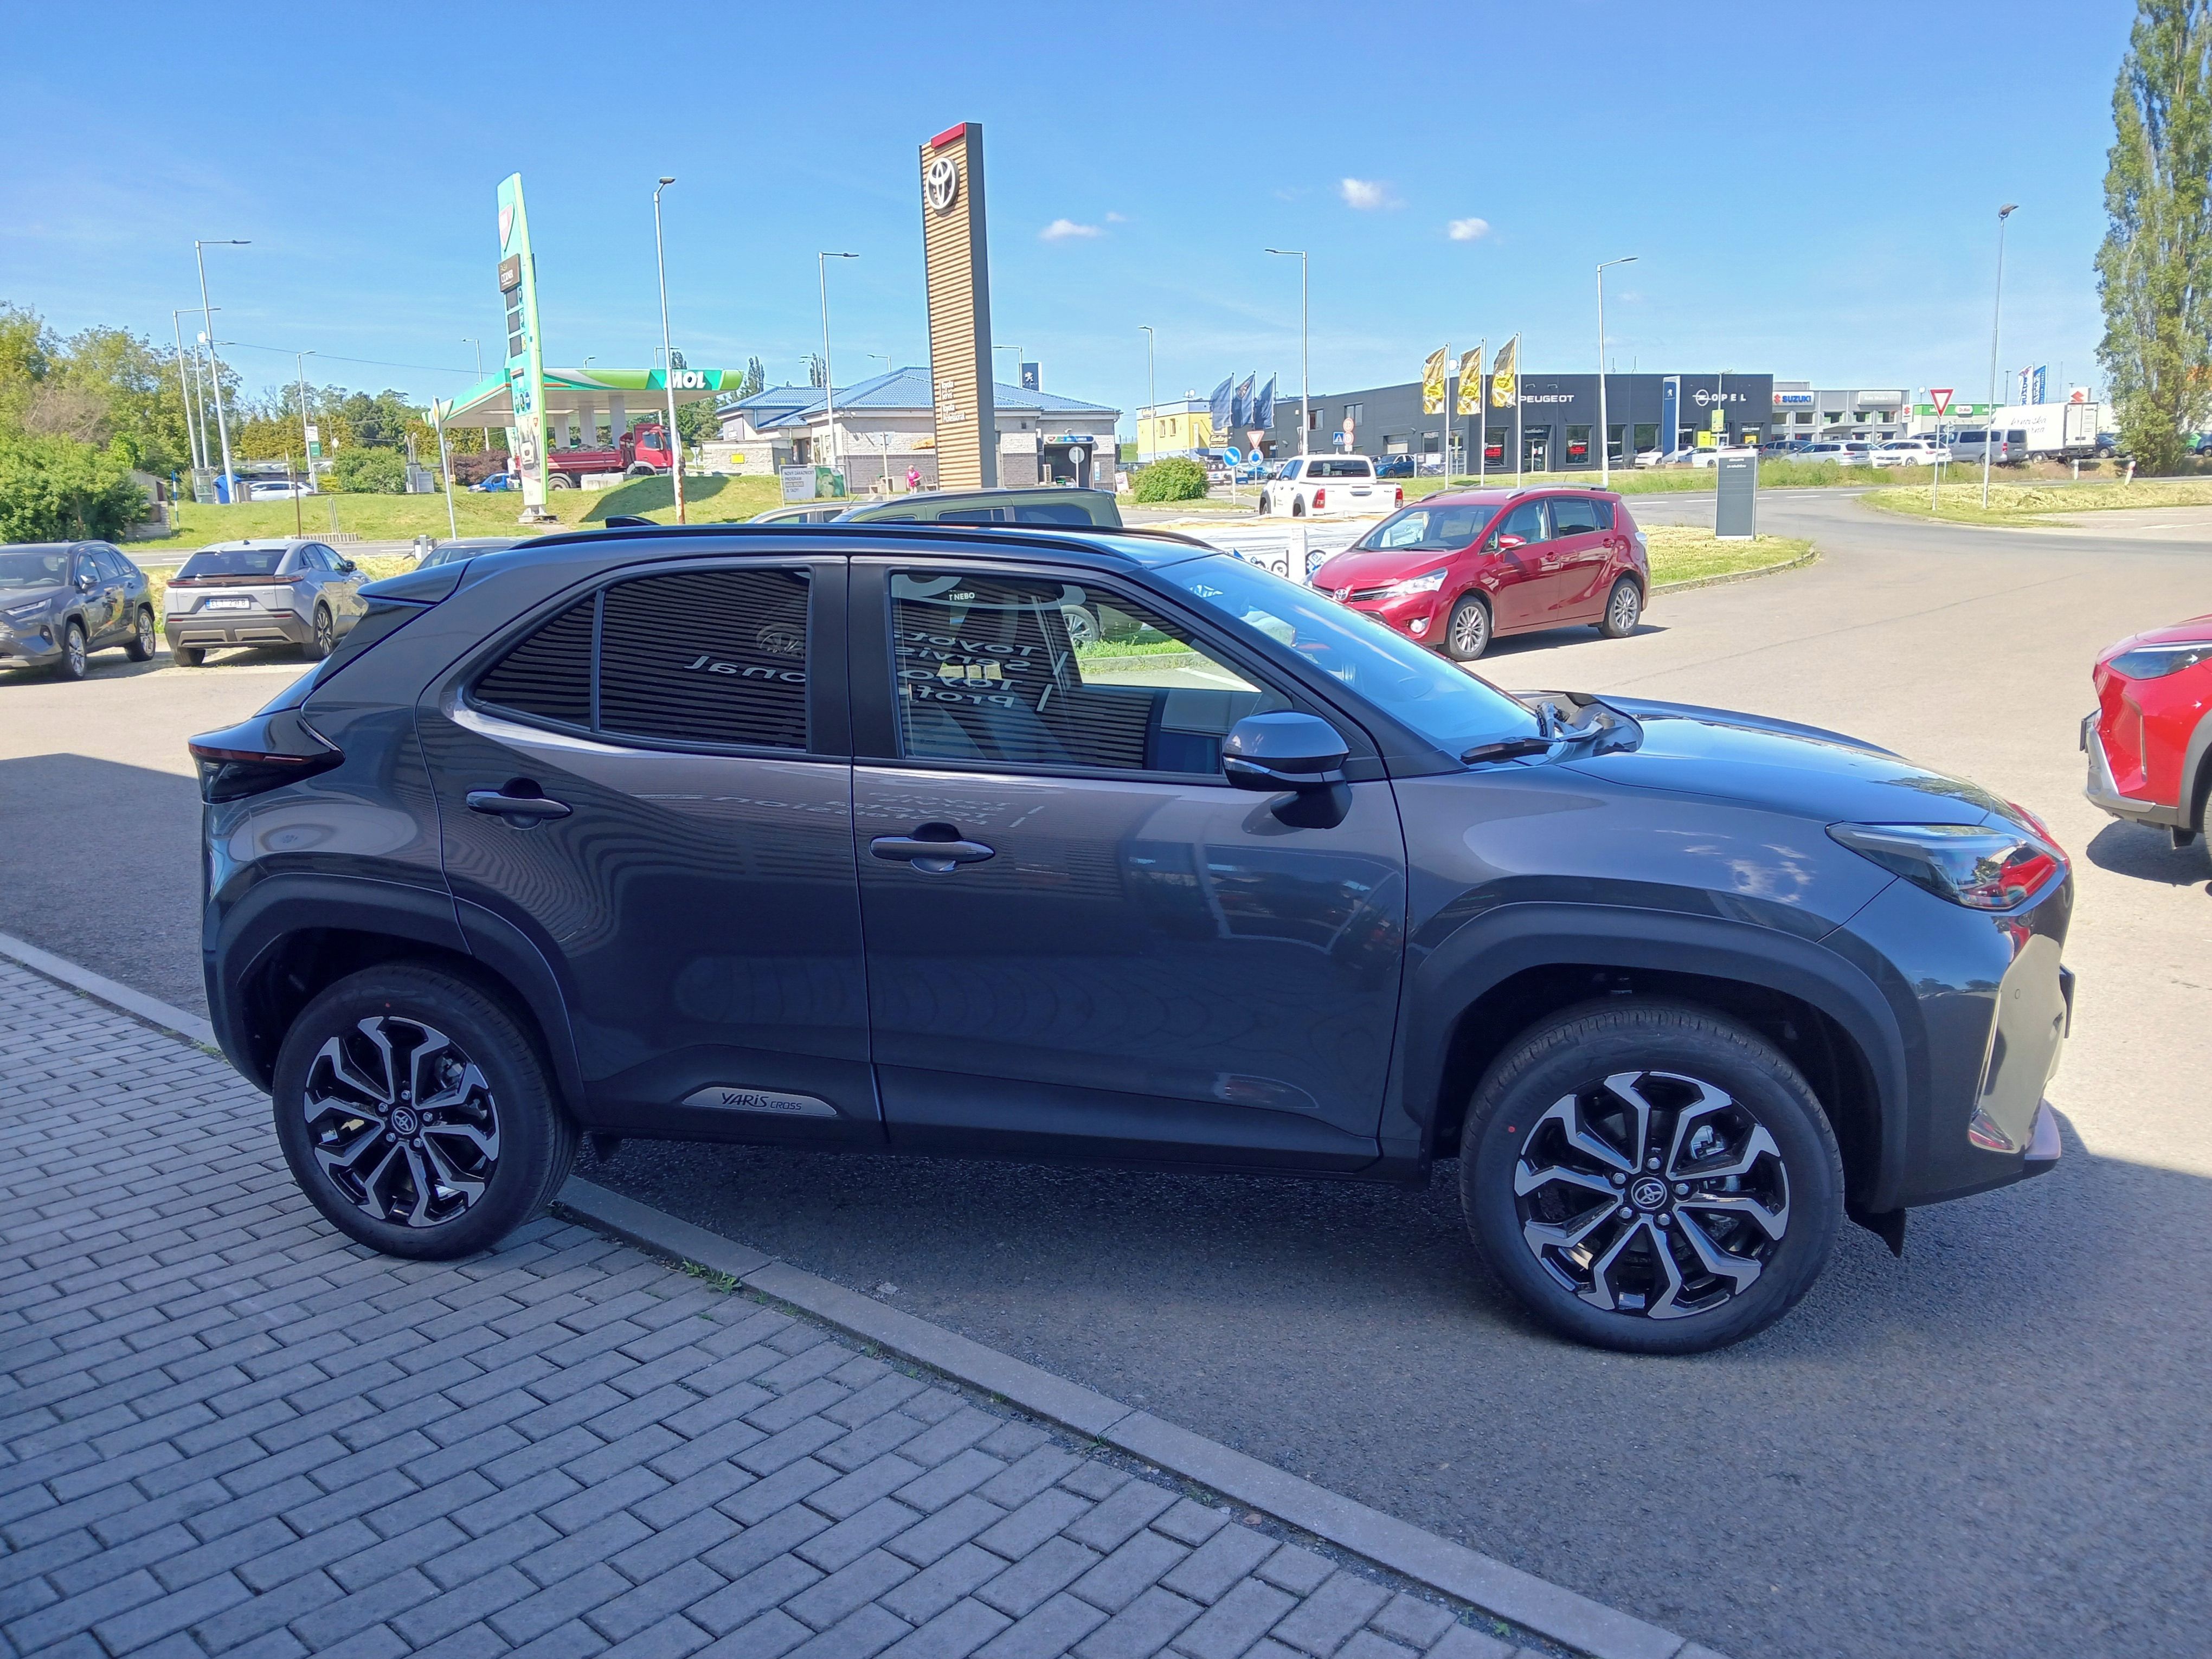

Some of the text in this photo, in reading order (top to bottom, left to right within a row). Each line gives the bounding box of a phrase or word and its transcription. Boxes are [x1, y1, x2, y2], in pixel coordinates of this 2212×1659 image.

[665, 371, 706, 389] MOL
[941, 381, 954, 391] Toyota
[1520, 395, 1574, 403] PEUGEOT
[1711, 394, 1746, 402] OPEL
[942, 403, 956, 416] Toyota
[954, 592, 975, 601] NEBO
[770, 1101, 802, 1110] CROSS
